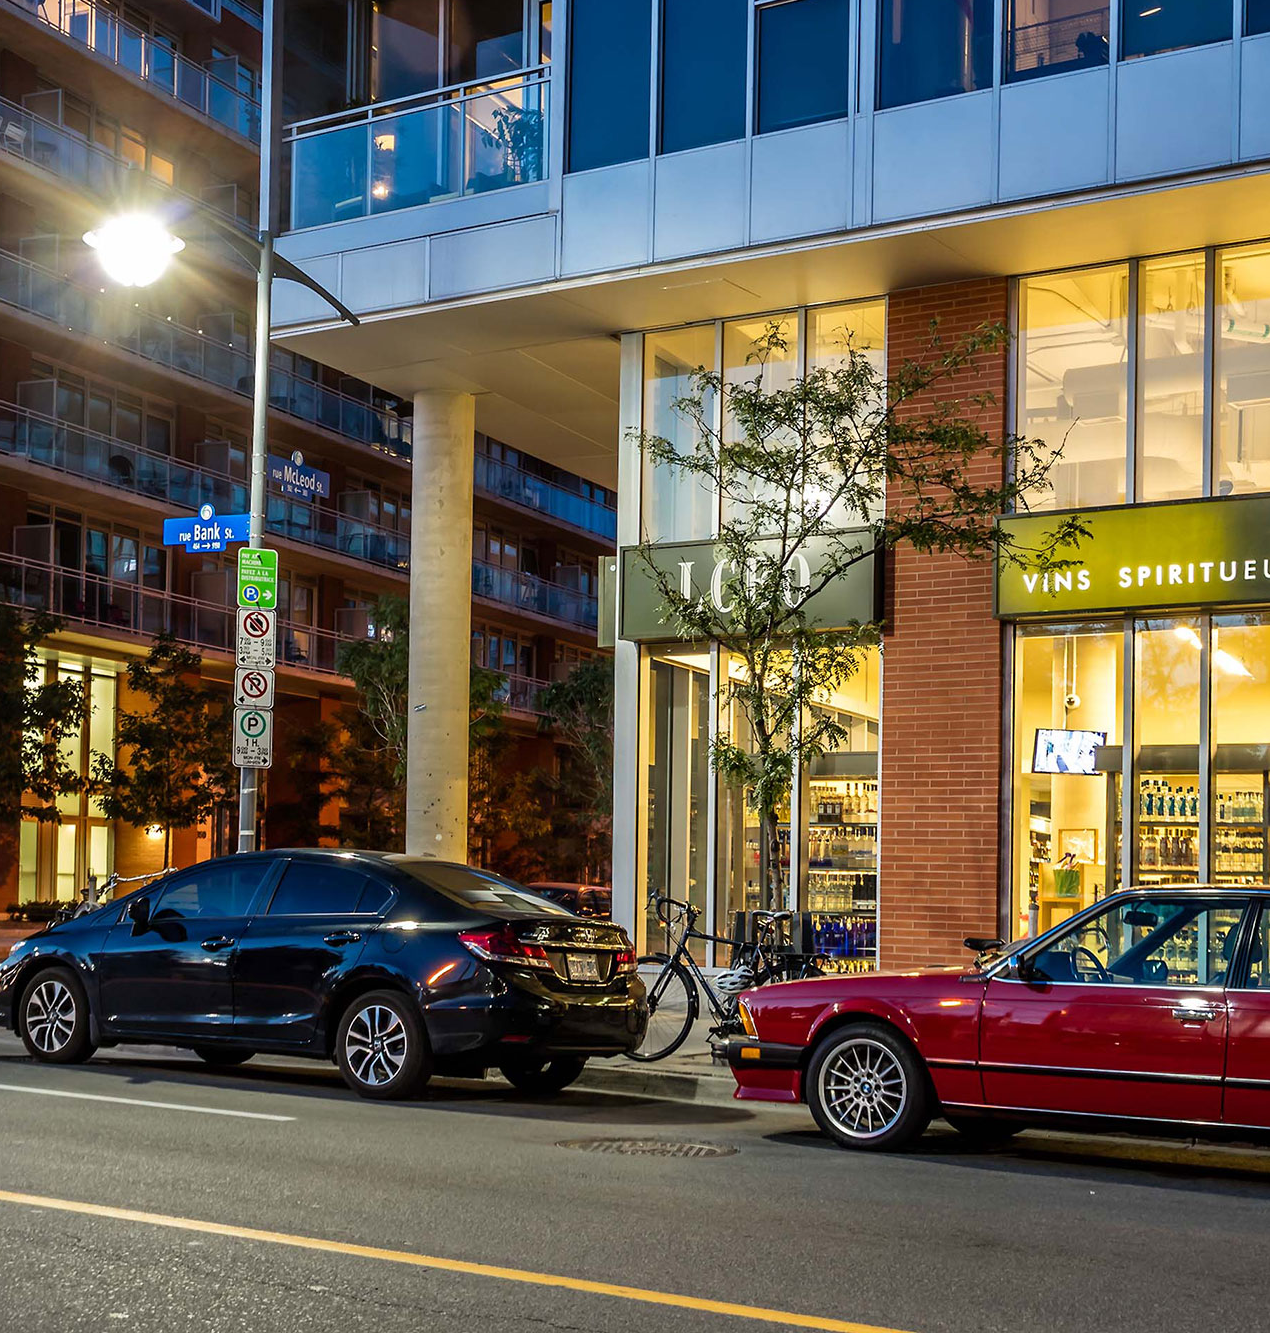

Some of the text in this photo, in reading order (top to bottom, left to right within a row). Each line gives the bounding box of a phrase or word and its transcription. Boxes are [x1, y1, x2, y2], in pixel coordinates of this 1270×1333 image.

[284, 465, 316, 491] McLeod
[179, 532, 192, 542] rue
[193, 522, 221, 541] Bank
[1021, 569, 1091, 595] VINS
